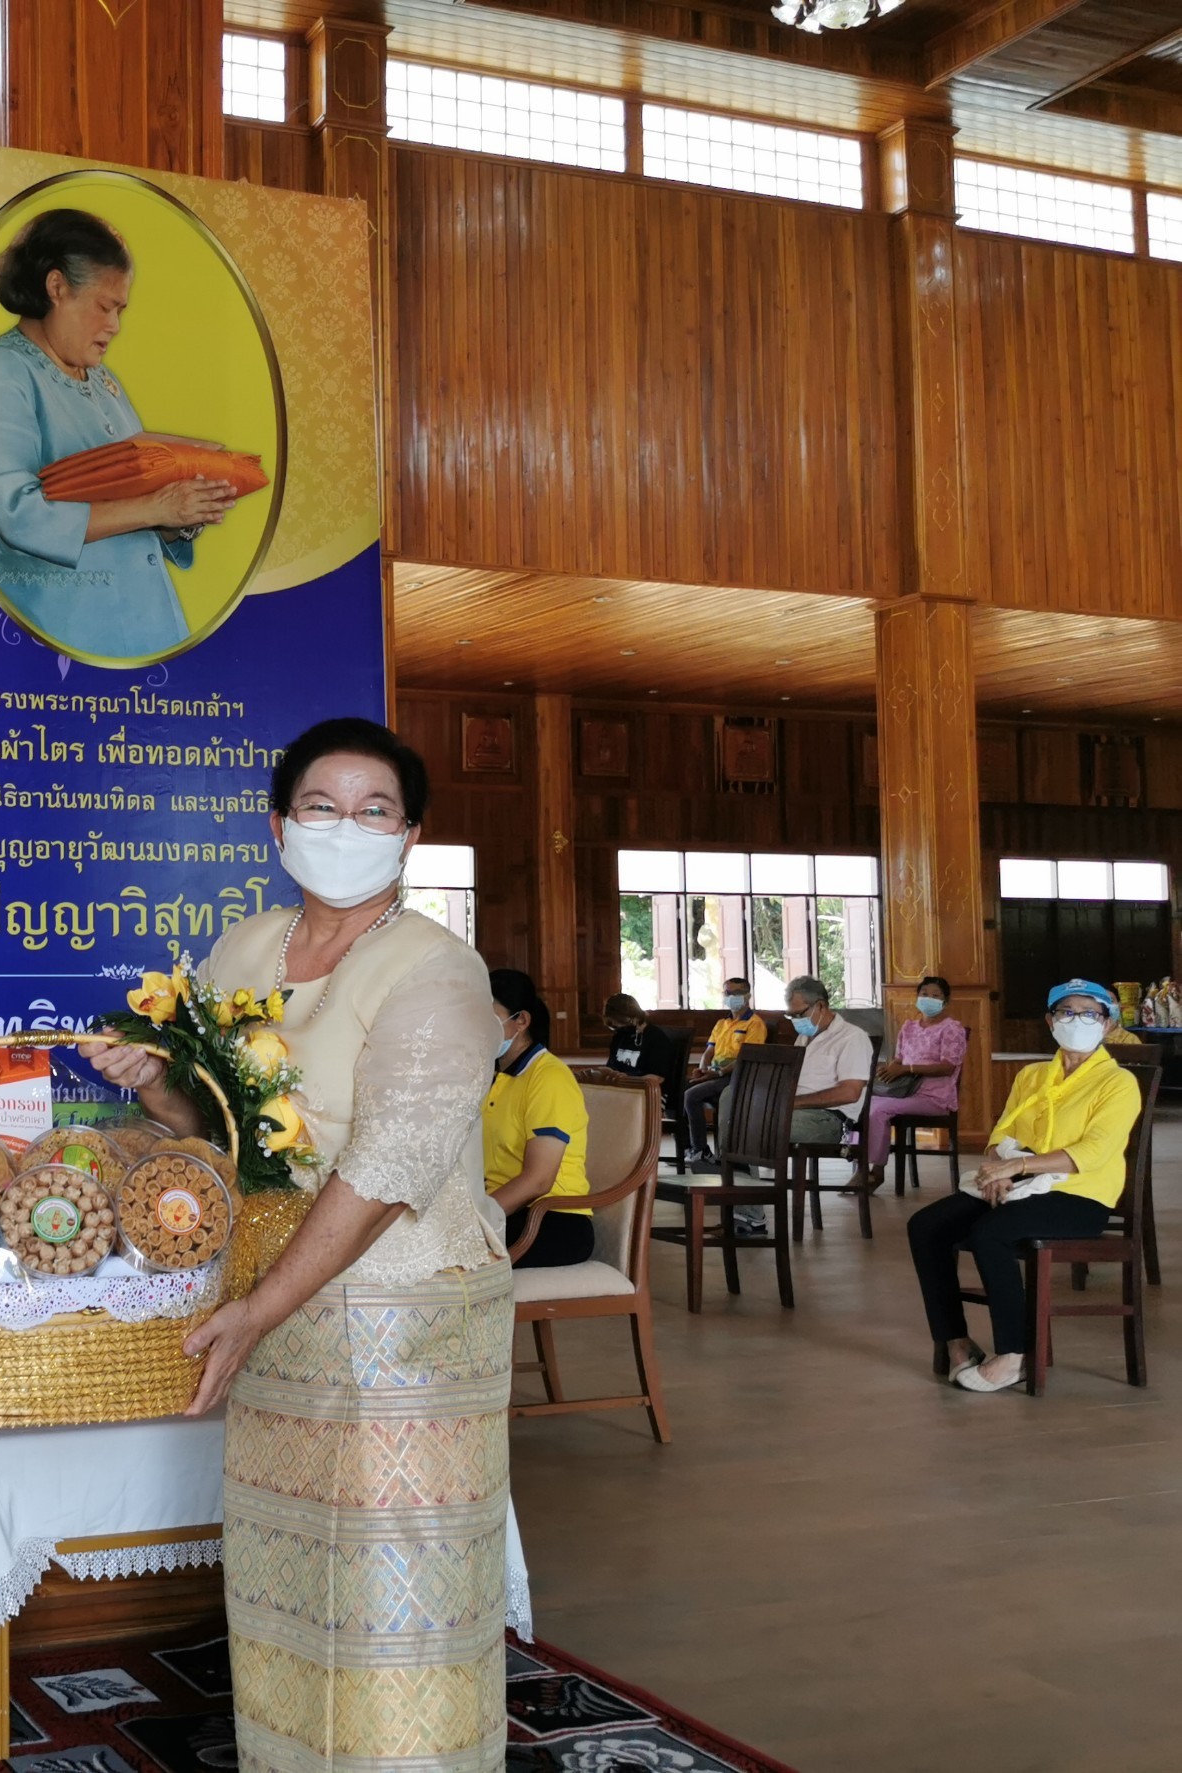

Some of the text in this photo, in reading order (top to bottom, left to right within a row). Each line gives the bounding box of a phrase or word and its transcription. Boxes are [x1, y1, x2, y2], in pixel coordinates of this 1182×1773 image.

[98, 725, 288, 768] เพื่อทอดผ้าป่าก
[171, 786, 275, 822] และมูลนิธิ
